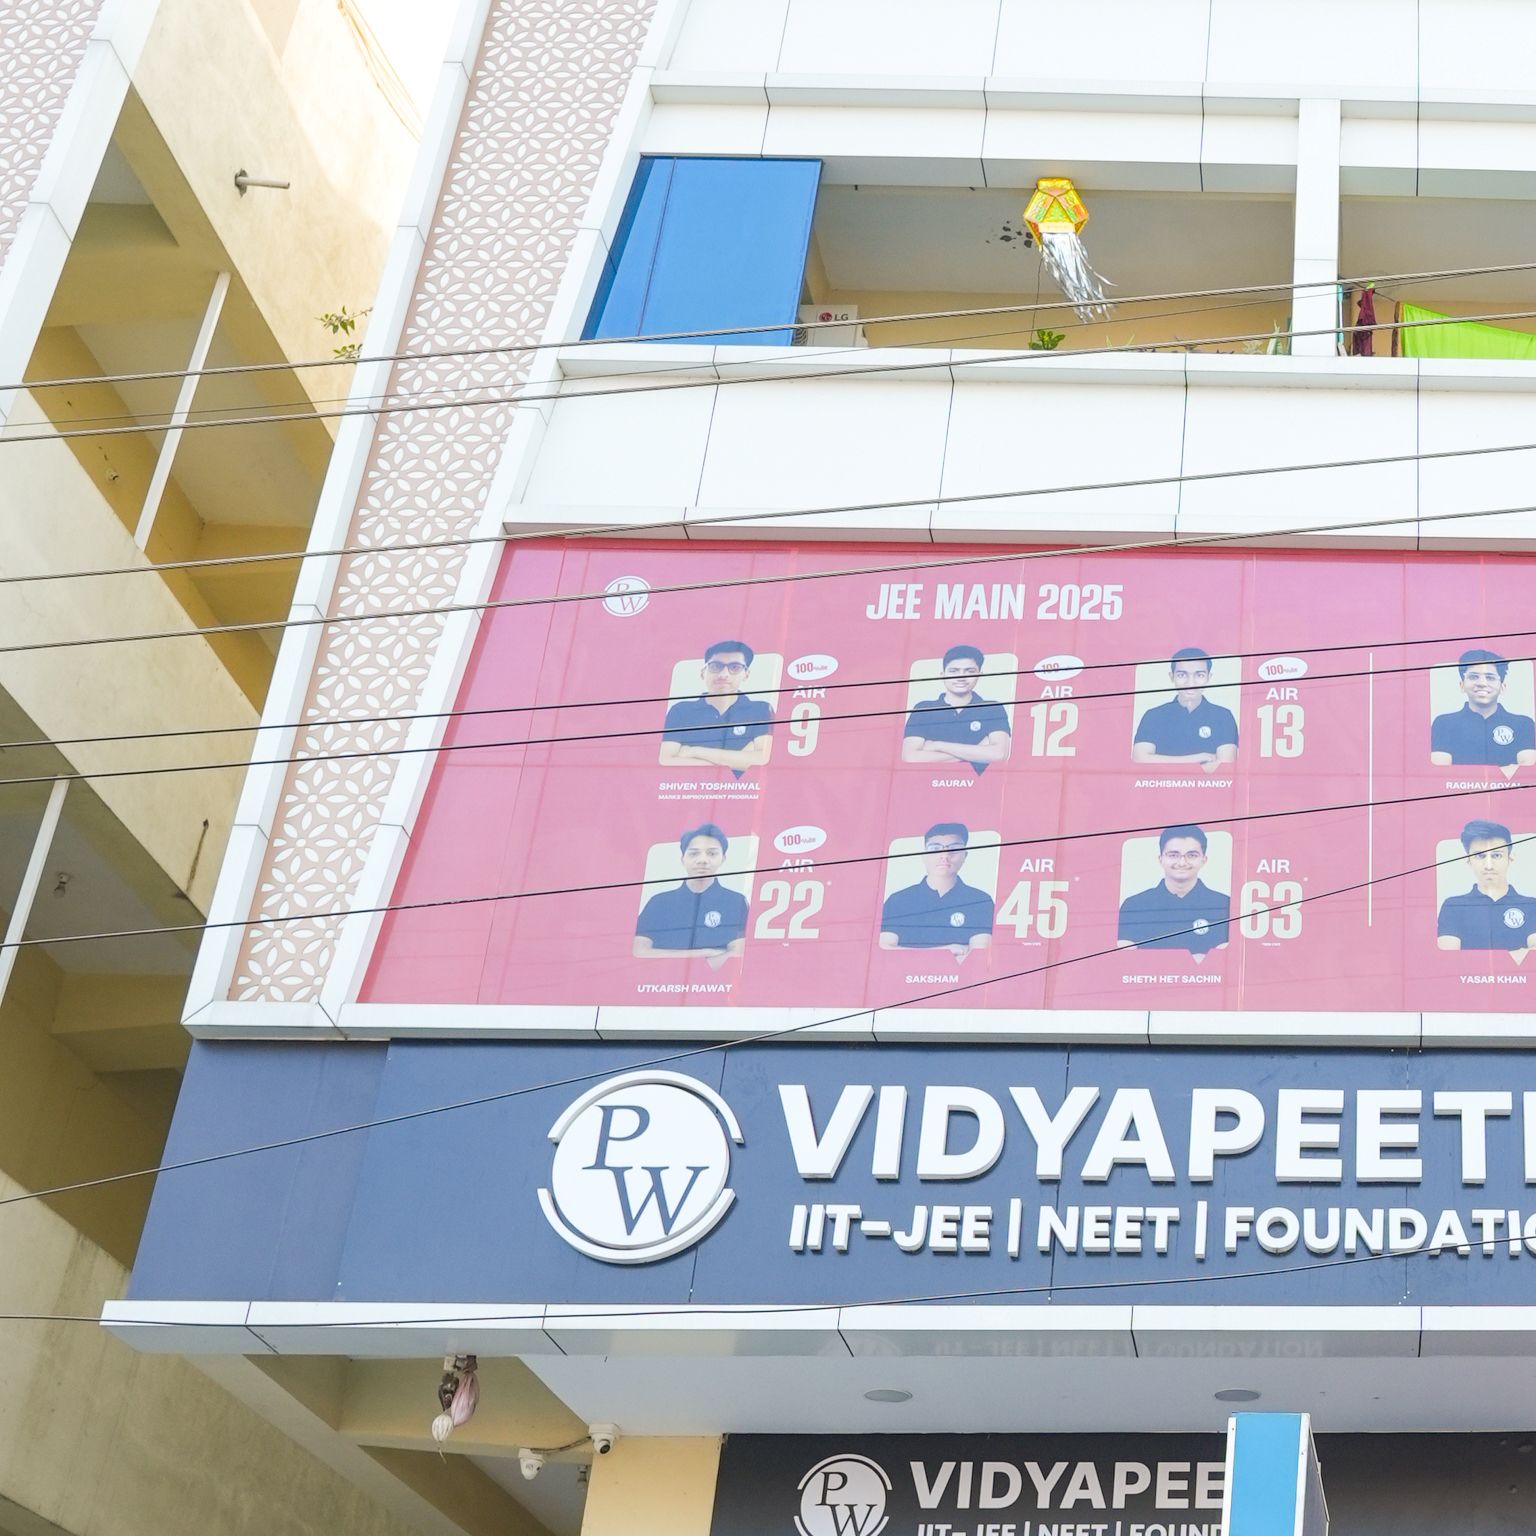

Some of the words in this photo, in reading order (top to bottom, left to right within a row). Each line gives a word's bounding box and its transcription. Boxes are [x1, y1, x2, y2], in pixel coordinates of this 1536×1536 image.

[866, 583, 923, 620] JEE
[934, 583, 1025, 620] MAIN
[1036, 584, 1123, 621] 2025
[792, 686, 826, 698] AIR
[1040, 685, 1073, 699] AIR
[1265, 687, 1298, 701] AIR
[787, 702, 820, 756] 9
[1030, 702, 1079, 757] 12
[1257, 704, 1305, 758] 13
[658, 782, 697, 791] SHIVEN
[699, 782, 760, 791] TOSHNIWAL
[931, 779, 974, 788] SAURAV
[1134, 779, 1196, 788] ARCHISMAN
[1197, 780, 1233, 789] NANDY
[1446, 782, 1488, 790] RAGHAV
[779, 859, 815, 873] AIR
[1020, 858, 1054, 873] AIR
[1256, 859, 1290, 873] AIR
[753, 880, 826, 939] 22
[996, 880, 1070, 939] 45
[1240, 880, 1303, 939] 63
[905, 975, 959, 984] SAKSHAM
[1122, 975, 1158, 984] SHETH
[1159, 975, 1180, 984] HET
[1181, 975, 1221, 984] SACHIN
[1460, 975, 1495, 984] YASAR
[1496, 975, 1527, 984] KHAN
[637, 983, 690, 994] UTKARSH
[691, 983, 733, 994] RAWAT
[790, 1203, 993, 1253] IIT-JEE
[1037, 1205, 1181, 1255] NEET
[910, 1461, 1227, 1509] VIDYAPEE
